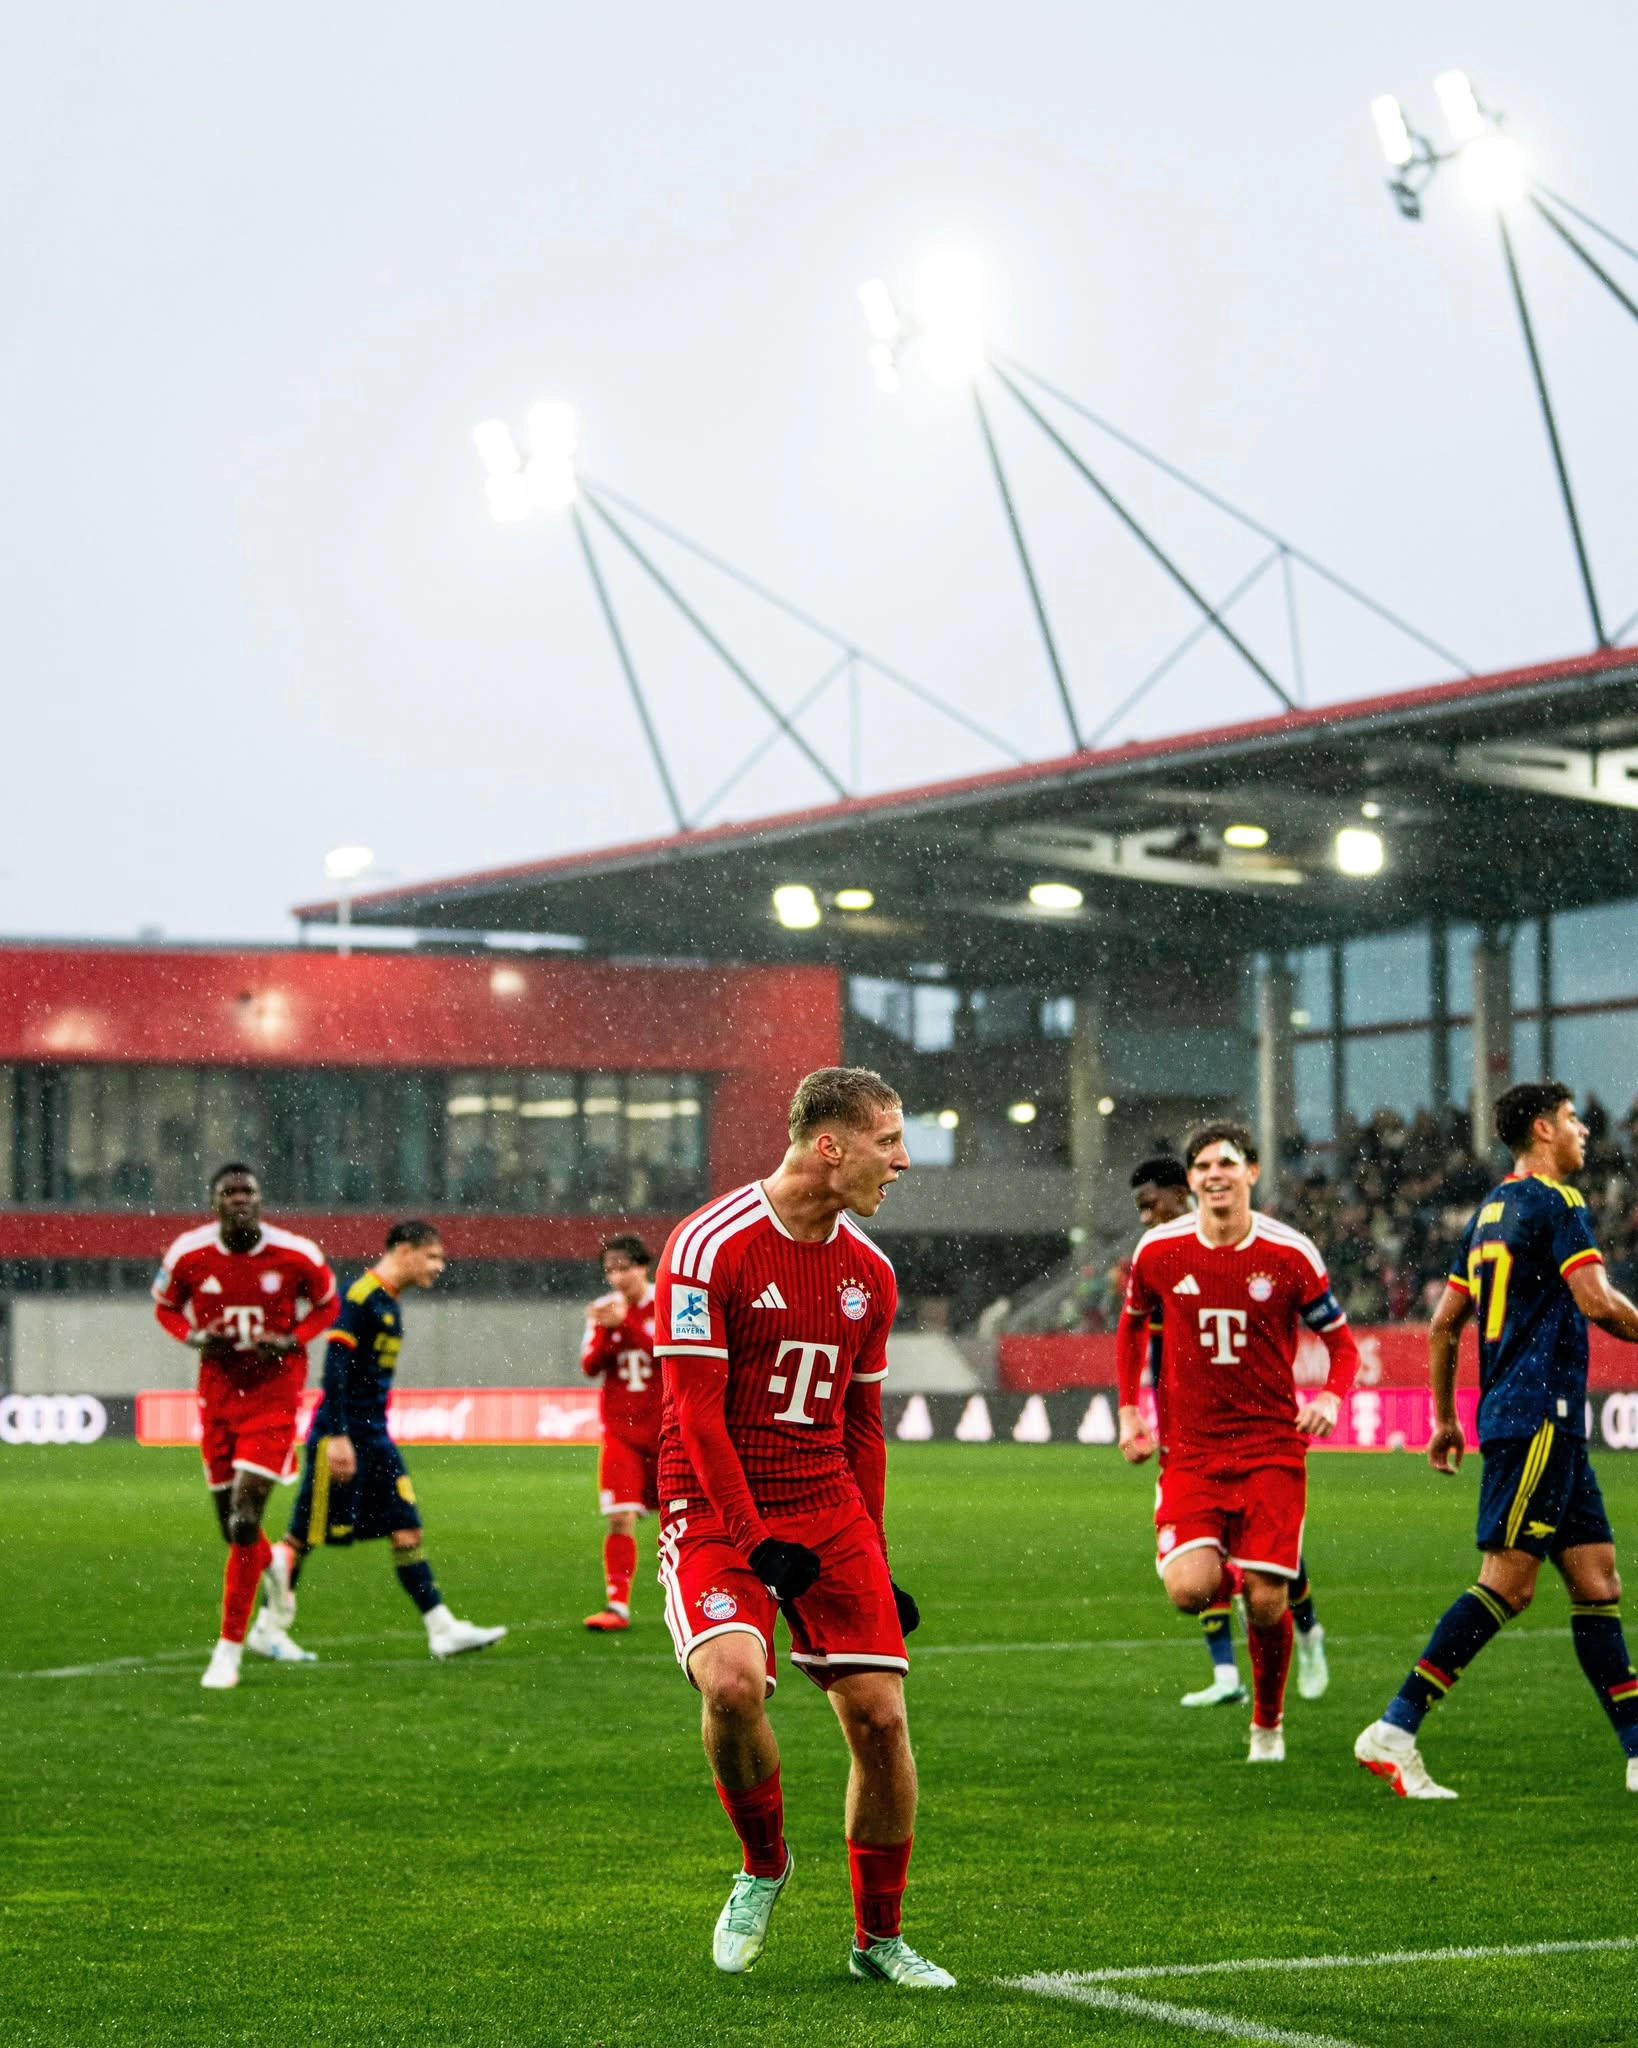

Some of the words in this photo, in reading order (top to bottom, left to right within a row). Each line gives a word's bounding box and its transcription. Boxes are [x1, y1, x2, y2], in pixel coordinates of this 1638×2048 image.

[675, 1327, 706, 1335] BAYERN
[1199, 1308, 1247, 1365] T
[616, 1350, 652, 1392] T
[768, 1340, 839, 1424] T
